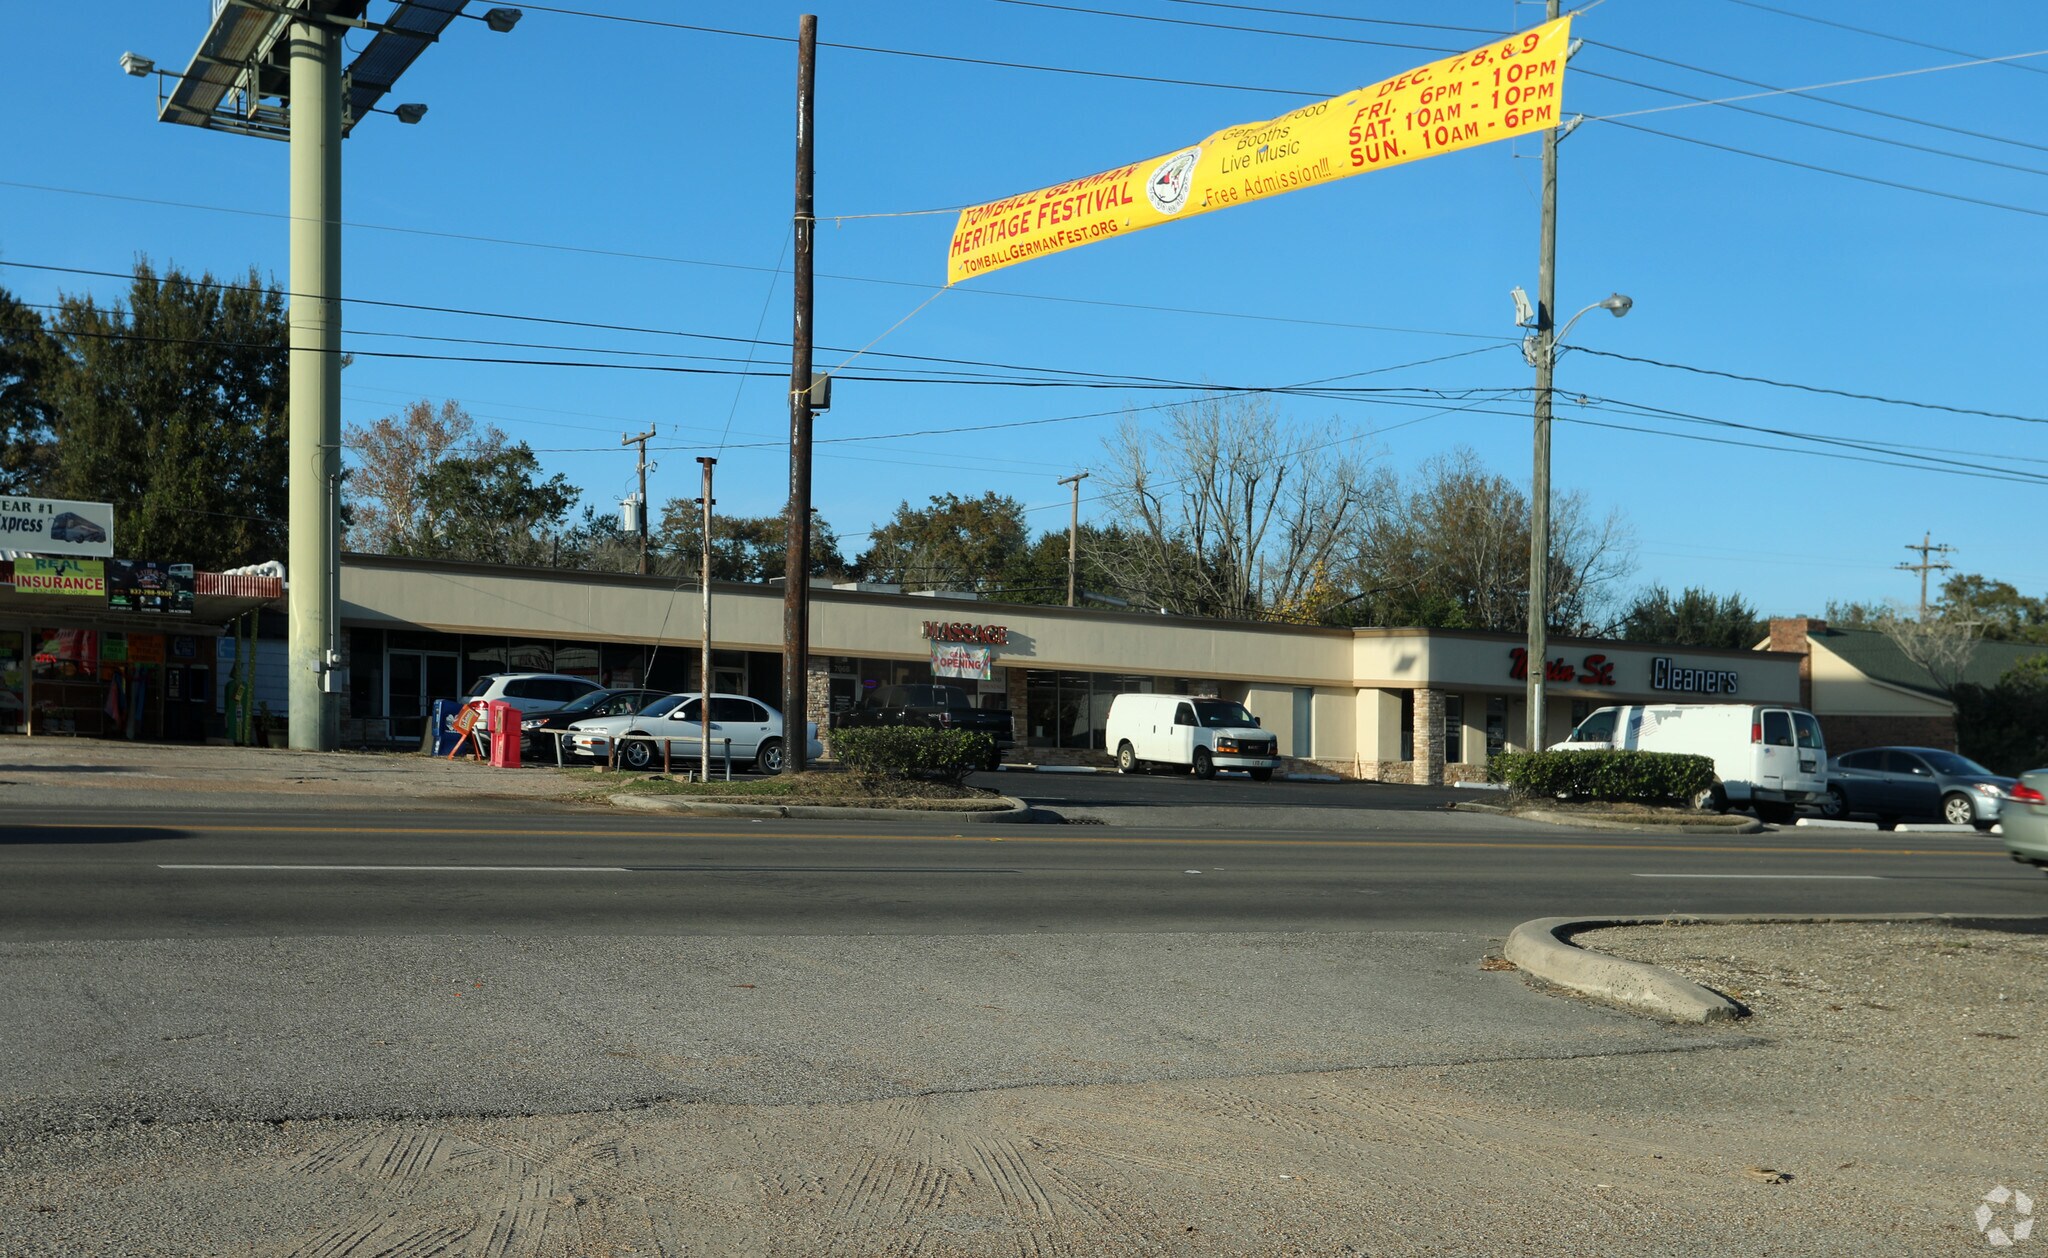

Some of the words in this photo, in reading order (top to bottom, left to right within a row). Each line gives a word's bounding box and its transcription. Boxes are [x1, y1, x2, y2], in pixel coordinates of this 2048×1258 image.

[1376, 68, 1433, 98] DEC.
[1500, 43, 1516, 60] &
[1521, 33, 1540, 54] 9
[1353, 99, 1397, 125] FRI.
[1420, 81, 1463, 105] 6PM
[1493, 60, 1556, 87] 10PM
[1348, 117, 1395, 146] SAT.
[1405, 103, 1461, 131] 10AM
[1491, 82, 1554, 110] 10PM
[1236, 126, 1291, 151] Booths
[1350, 138, 1407, 167] SUN.
[1422, 122, 1479, 149] 10AM
[1504, 105, 1552, 128] 6PM
[1221, 155, 1251, 174] Live
[1255, 139, 1300, 165] Music
[1205, 187, 1239, 207] Free
[1244, 157, 1332, 198] Admission!!!
[951, 210, 1032, 258] HERITAGE
[1036, 181, 1134, 229] FESTIVAL
[0, 500, 31, 513] EAR
[38, 503, 54, 514] #1
[0, 515, 43, 534] xpress
[35, 558, 84, 573] REAL
[16, 575, 104, 591] INSURANCE
[922, 620, 1010, 645] MASSAGE
[940, 657, 982, 670] OPENING
[949, 651, 971, 660] GRAND
[1652, 657, 1738, 695] Cleaners
